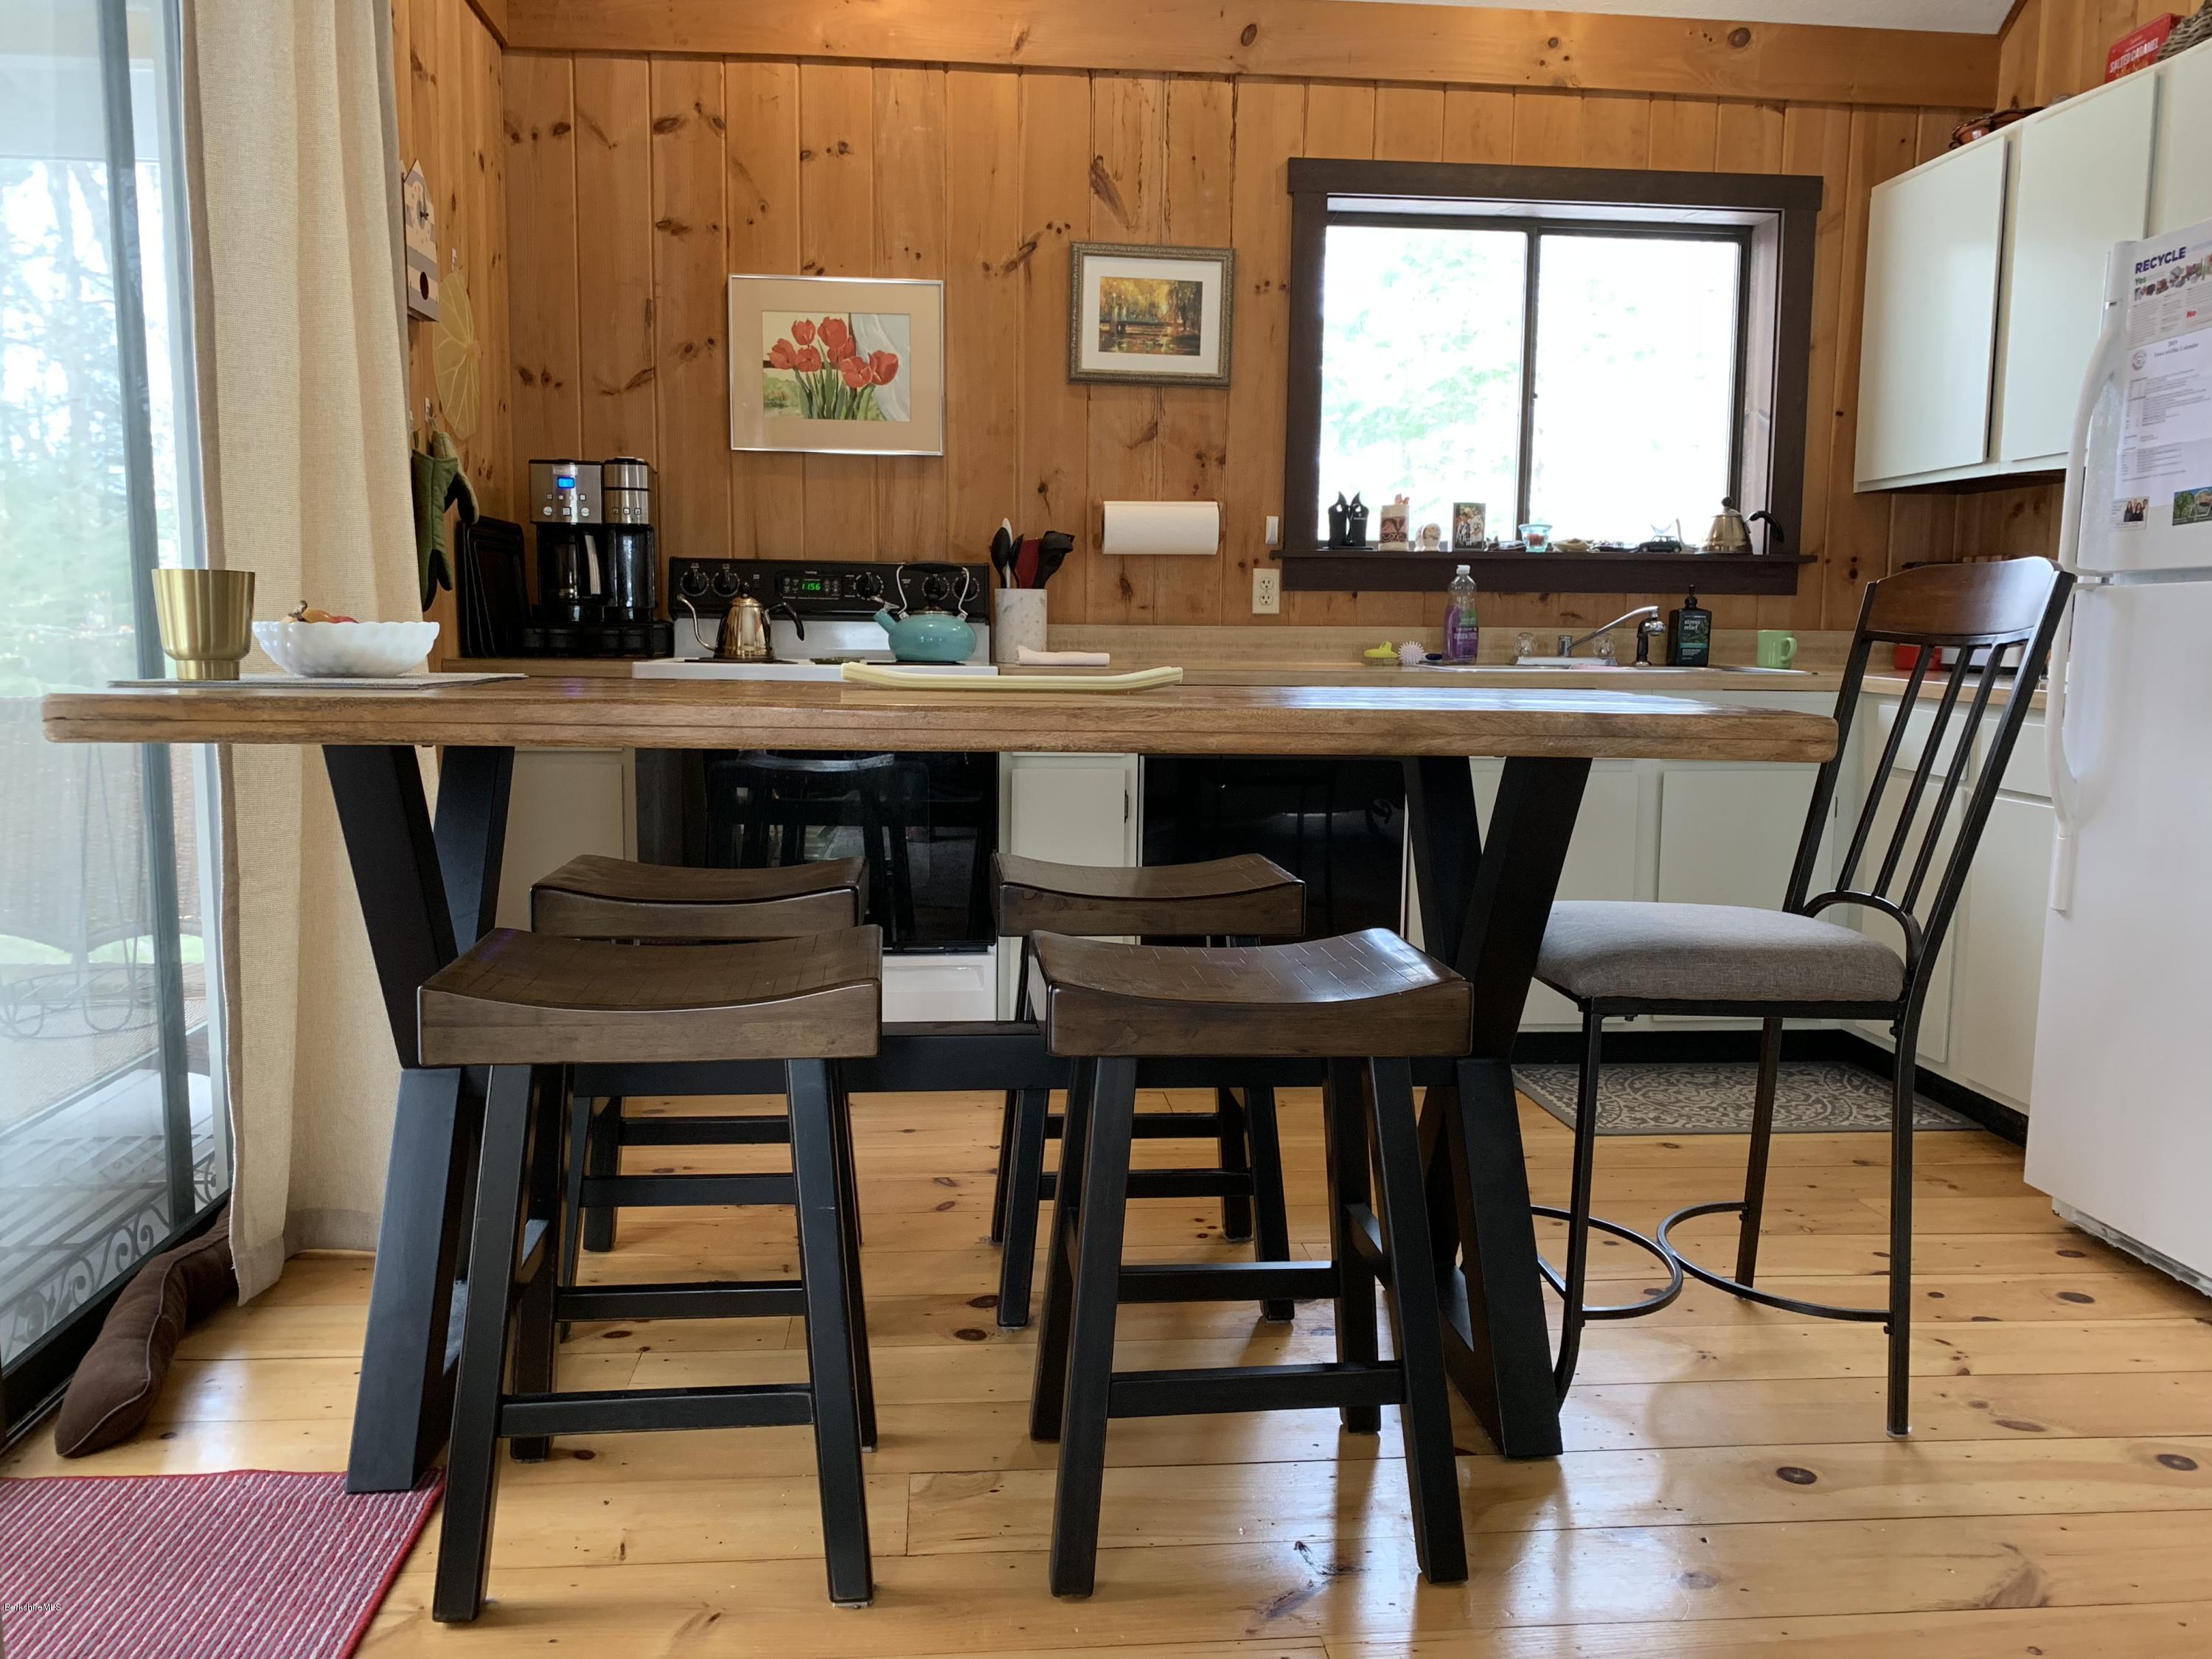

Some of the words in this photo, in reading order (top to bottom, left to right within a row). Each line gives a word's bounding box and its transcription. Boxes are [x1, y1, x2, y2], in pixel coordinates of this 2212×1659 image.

[2109, 52, 2131, 73] SALTED
[2131, 38, 2159, 61] CARAMEL
[2135, 246, 2187, 274] RECYCLE
[2135, 277, 2146, 285] Yes
